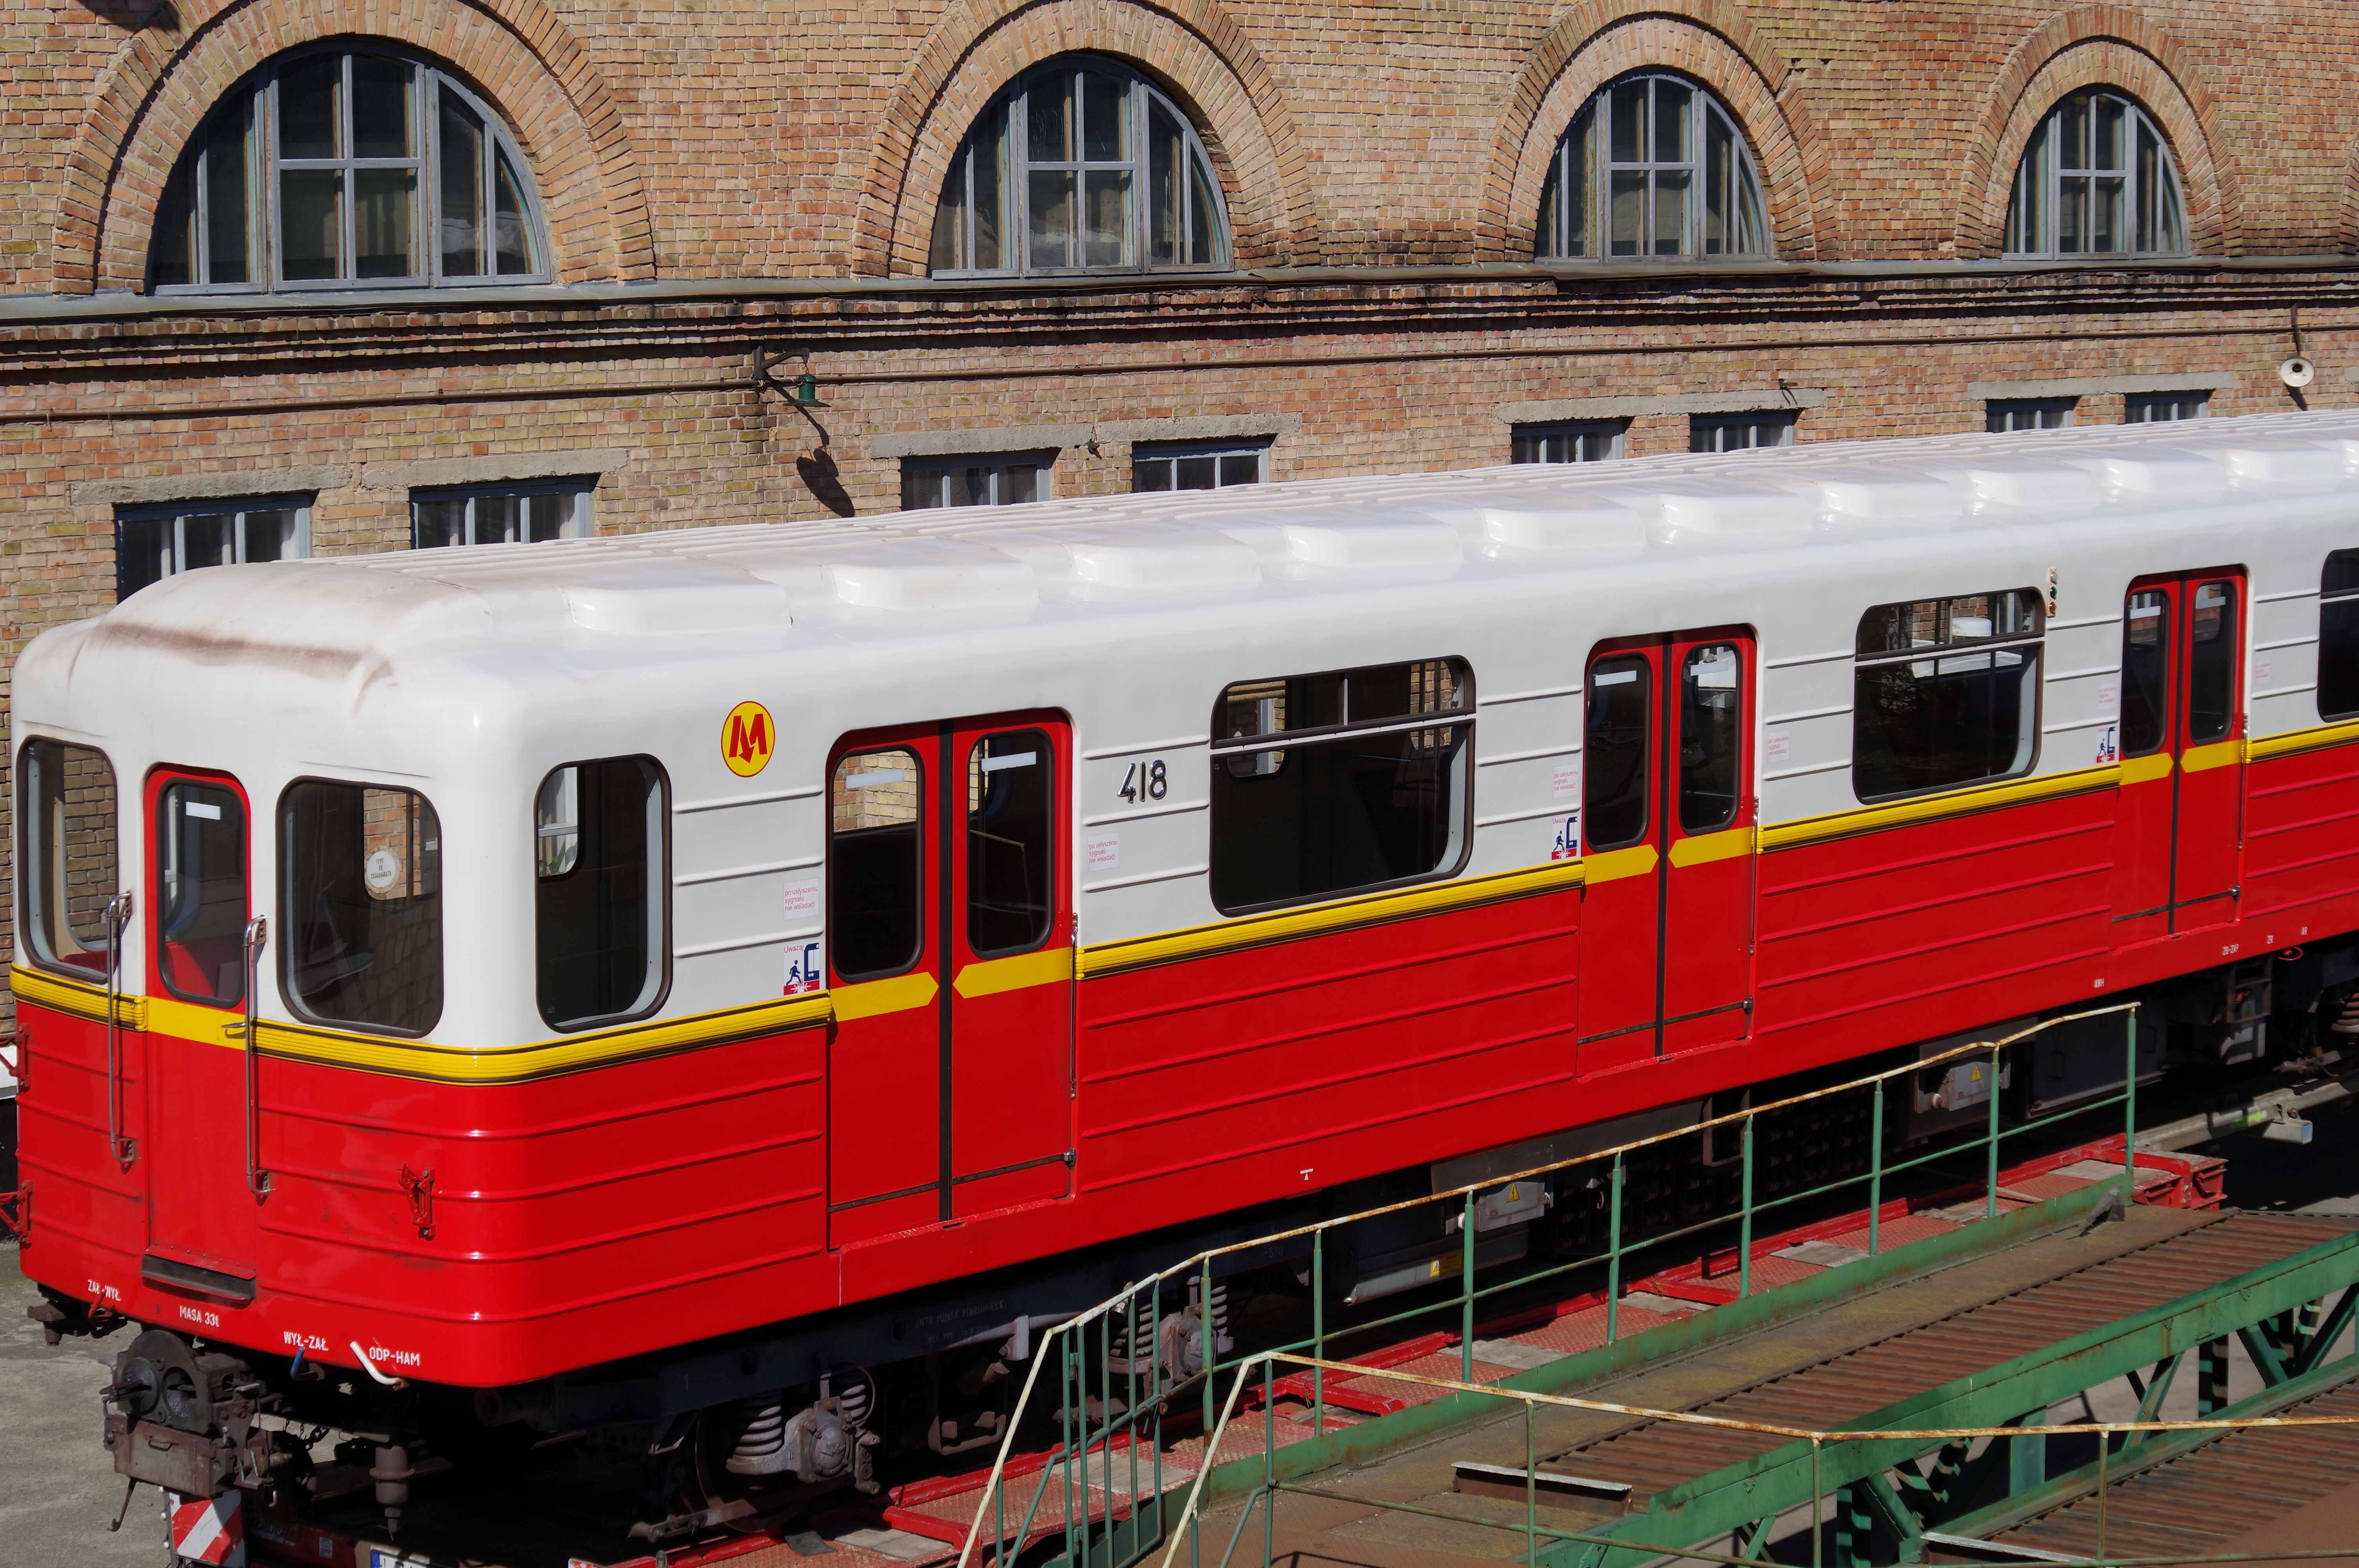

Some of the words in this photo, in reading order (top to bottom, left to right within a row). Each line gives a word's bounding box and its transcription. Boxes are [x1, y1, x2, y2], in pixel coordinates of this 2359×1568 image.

[1117, 760, 1167, 804] 418
[792, 886, 818, 895] usłyszeniu
[785, 896, 804, 904] sygnału
[794, 901, 815, 909] wsiadać!
[2301, 927, 2308, 935] AR
[2267, 935, 2274, 944] ZR
[784, 944, 804, 953] Uważaj
[2223, 944, 2239, 955] ZB-ZAP
[2094, 978, 2105, 988] AWH
[179, 1305, 202, 1323] MASA
[204, 1312, 220, 1328] 33t
[283, 1331, 329, 1351] WYŁ-ZAŁ
[369, 1347, 420, 1367] ODP-HAM
